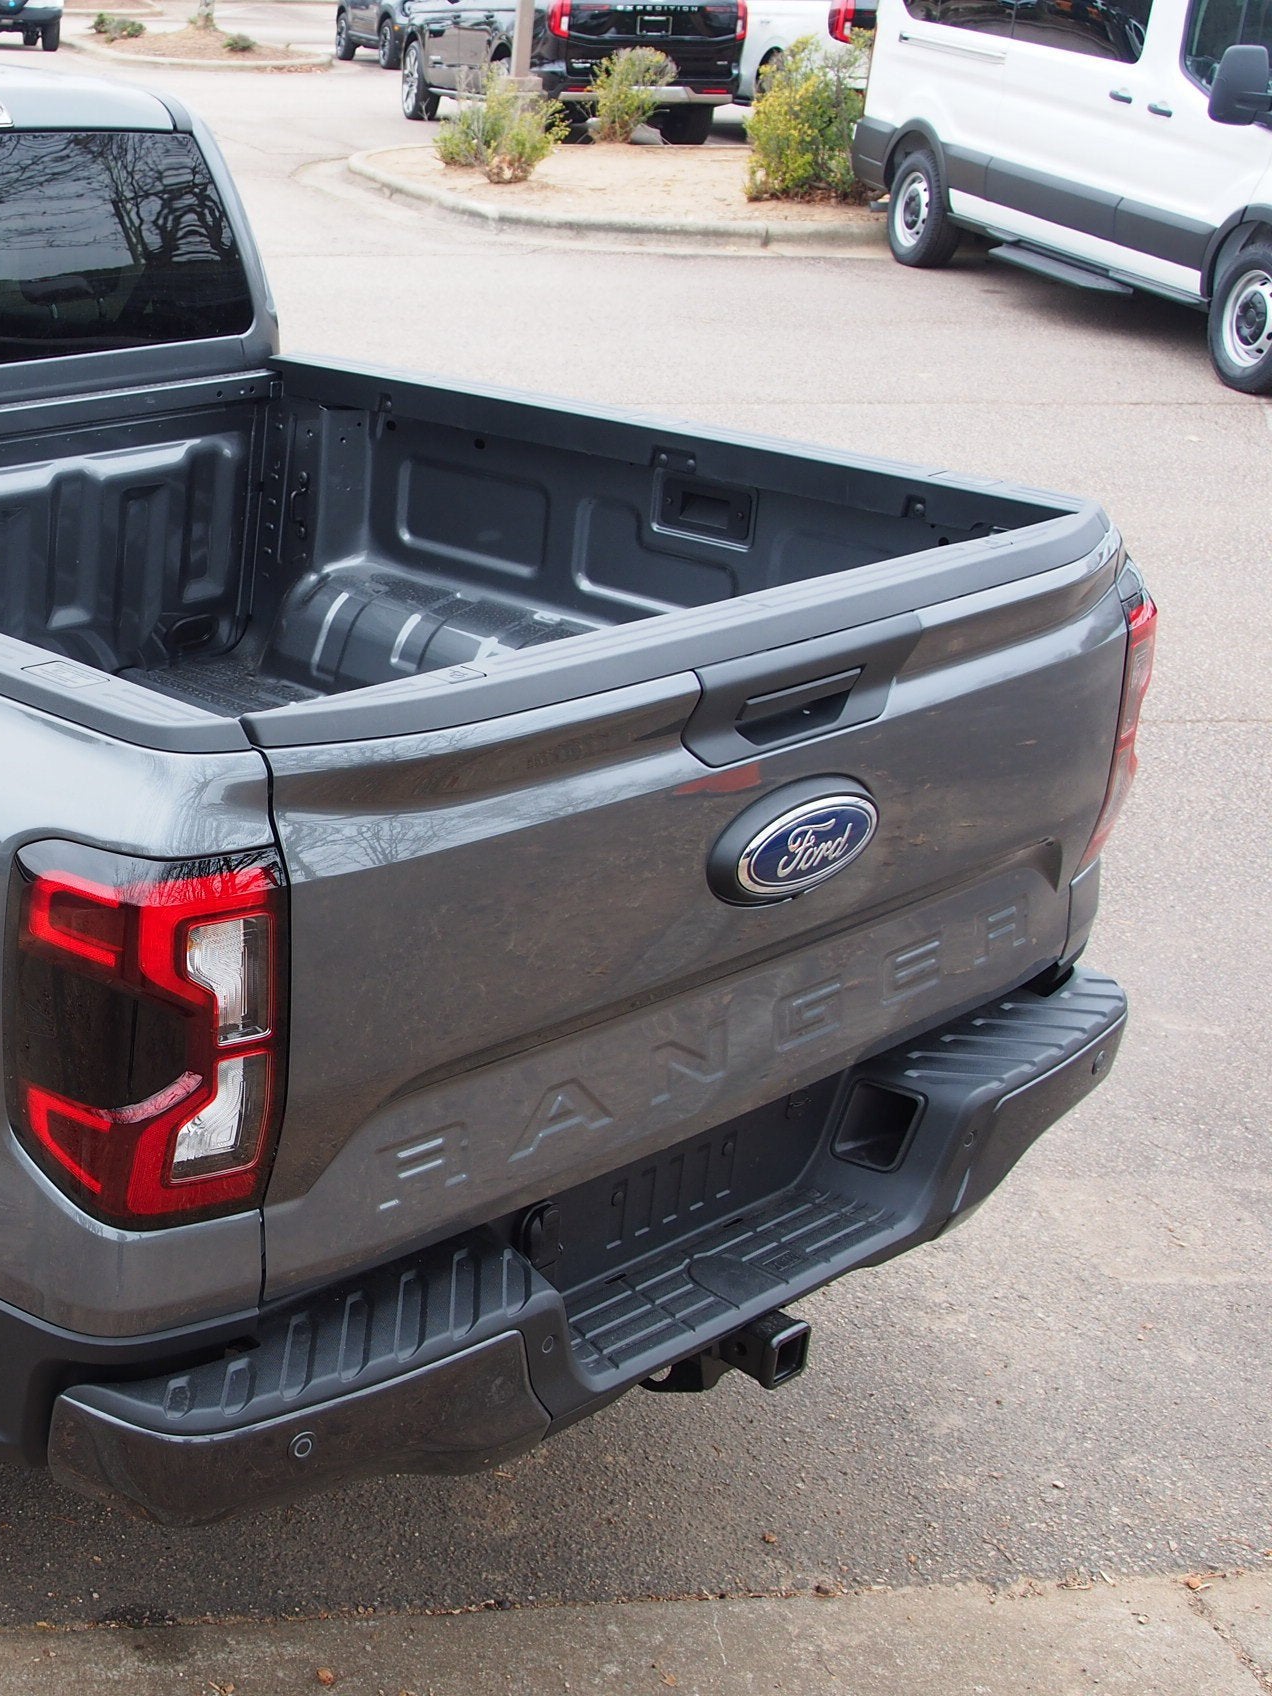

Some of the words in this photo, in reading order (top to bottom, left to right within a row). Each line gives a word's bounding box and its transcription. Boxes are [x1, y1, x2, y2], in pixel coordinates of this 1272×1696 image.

[616, 4, 699, 12] EXPEDITION
[776, 818, 853, 877] Ford
[376, 899, 1028, 1211] RANGER
